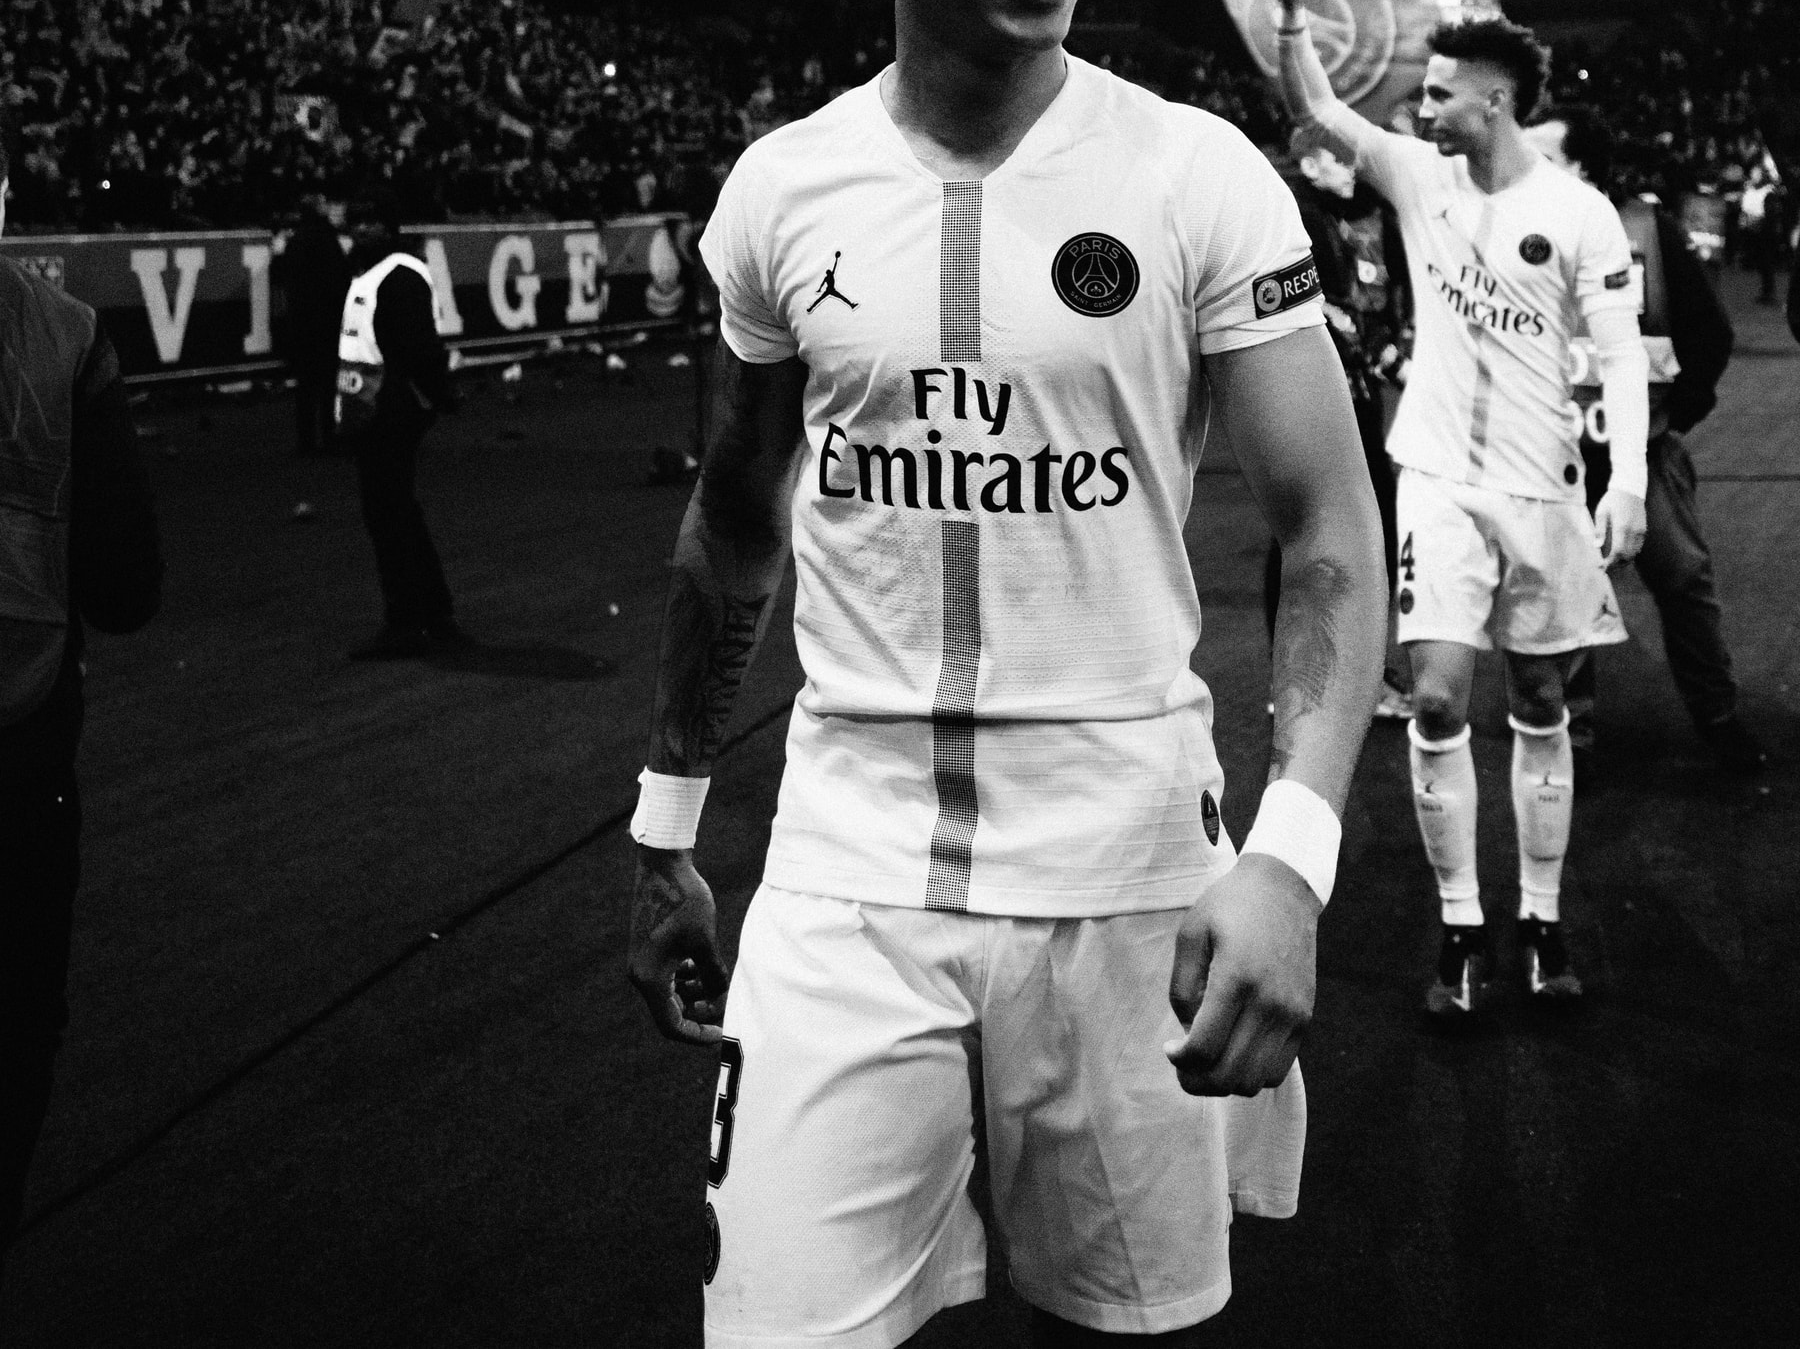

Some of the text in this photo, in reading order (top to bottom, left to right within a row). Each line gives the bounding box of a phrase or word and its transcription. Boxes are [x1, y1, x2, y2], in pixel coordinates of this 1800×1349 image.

[1068, 239, 1121, 259] PARIS
[910, 367, 1012, 435] Fly
[819, 422, 1129, 513] Emirates
